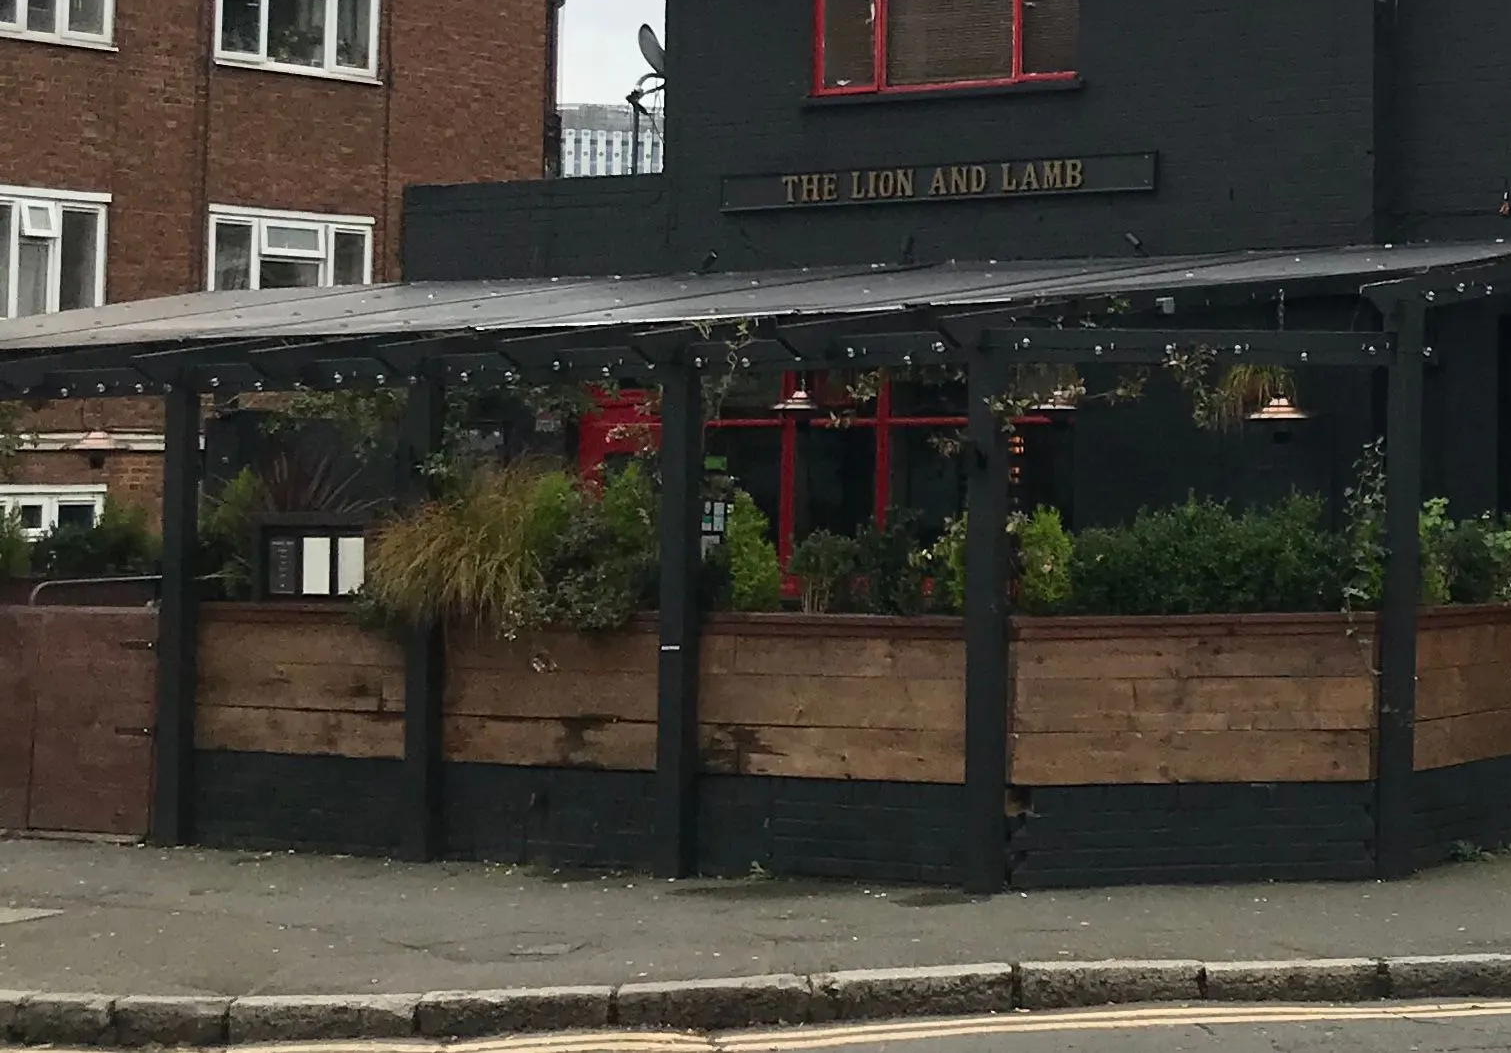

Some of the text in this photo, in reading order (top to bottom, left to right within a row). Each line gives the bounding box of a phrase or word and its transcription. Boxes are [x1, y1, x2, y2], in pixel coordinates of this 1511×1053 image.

[782, 158, 1083, 203] THE LION AND LAMB
